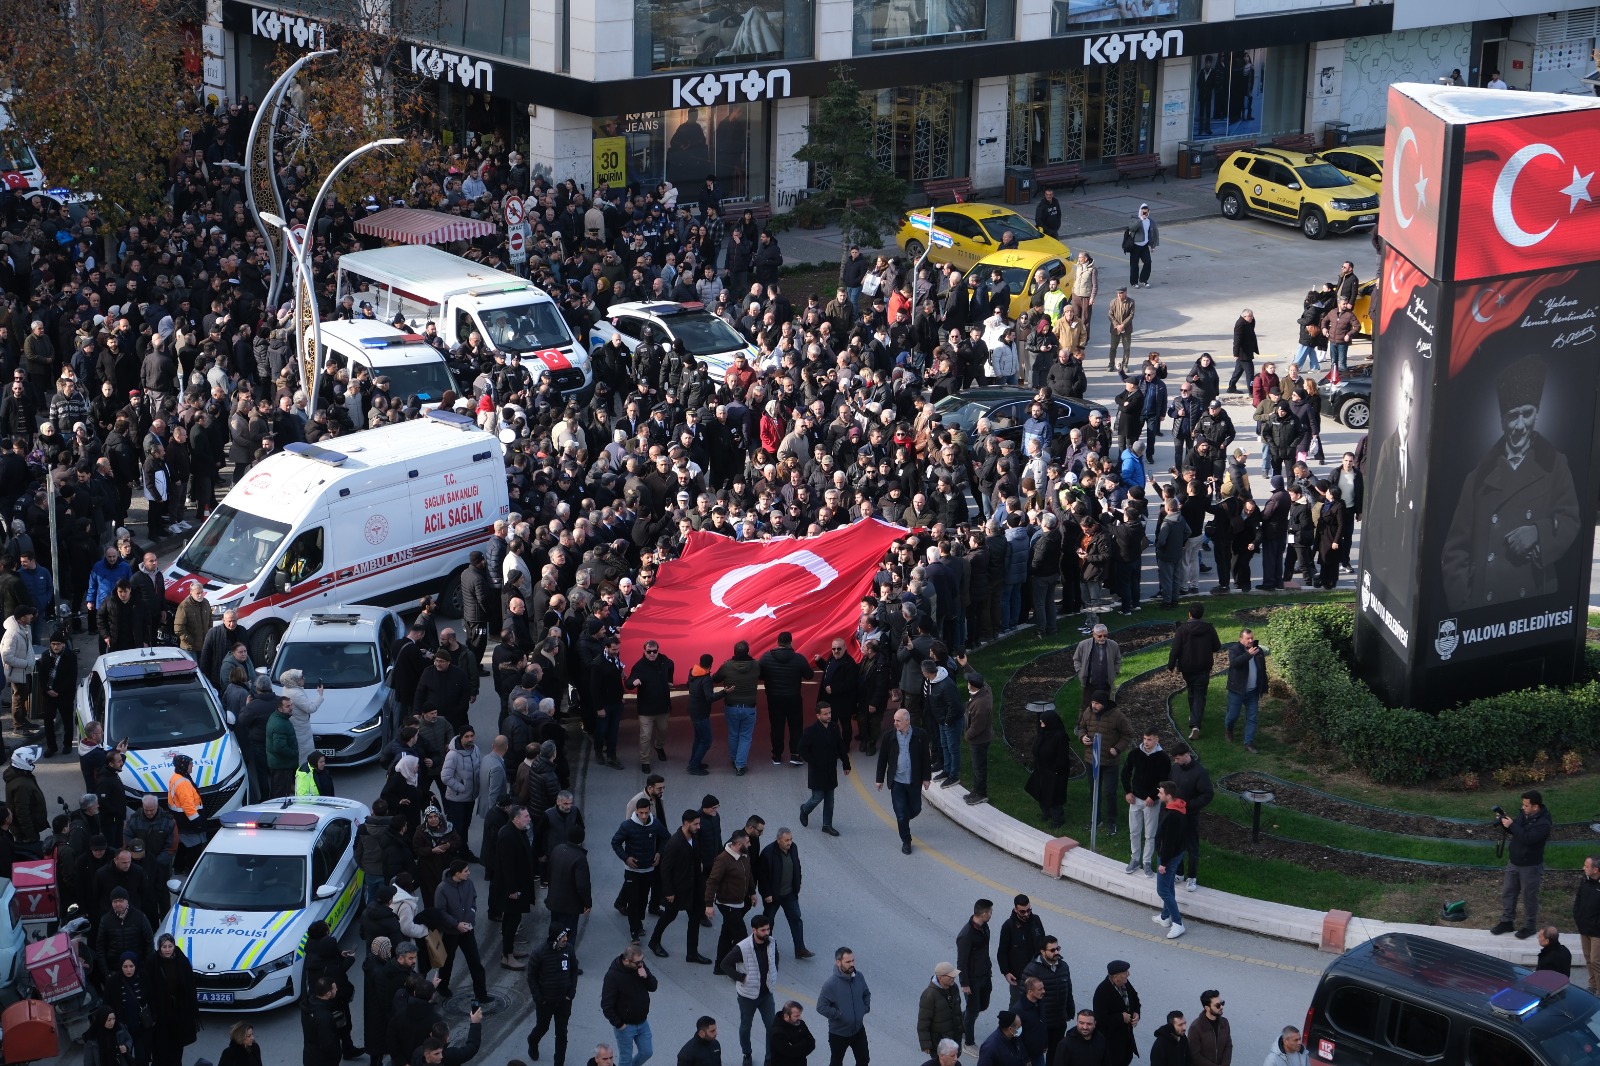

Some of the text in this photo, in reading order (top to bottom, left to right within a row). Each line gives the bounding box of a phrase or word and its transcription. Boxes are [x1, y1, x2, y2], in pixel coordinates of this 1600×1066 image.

[1083, 29, 1184, 66] KOTON
[410, 45, 493, 92] KOTON
[672, 68, 791, 108] KOTON
[625, 121, 659, 133] JEANS
[443, 473, 457, 486] T.C.
[424, 484, 479, 510] SAĞLIK BAKANLIĞI
[499, 504, 509, 515] 112
[448, 501, 484, 528] SAĞLIK
[353, 548, 414, 576] AMBULANS
[1462, 605, 1573, 645] YALOVA BELEDİYESİ
[182, 926, 268, 938] TRAFİK POLİSİ
[202, 993, 209, 1001] A
[210, 993, 231, 1001] 3326
[1321, 1041, 1333, 1053] 112
